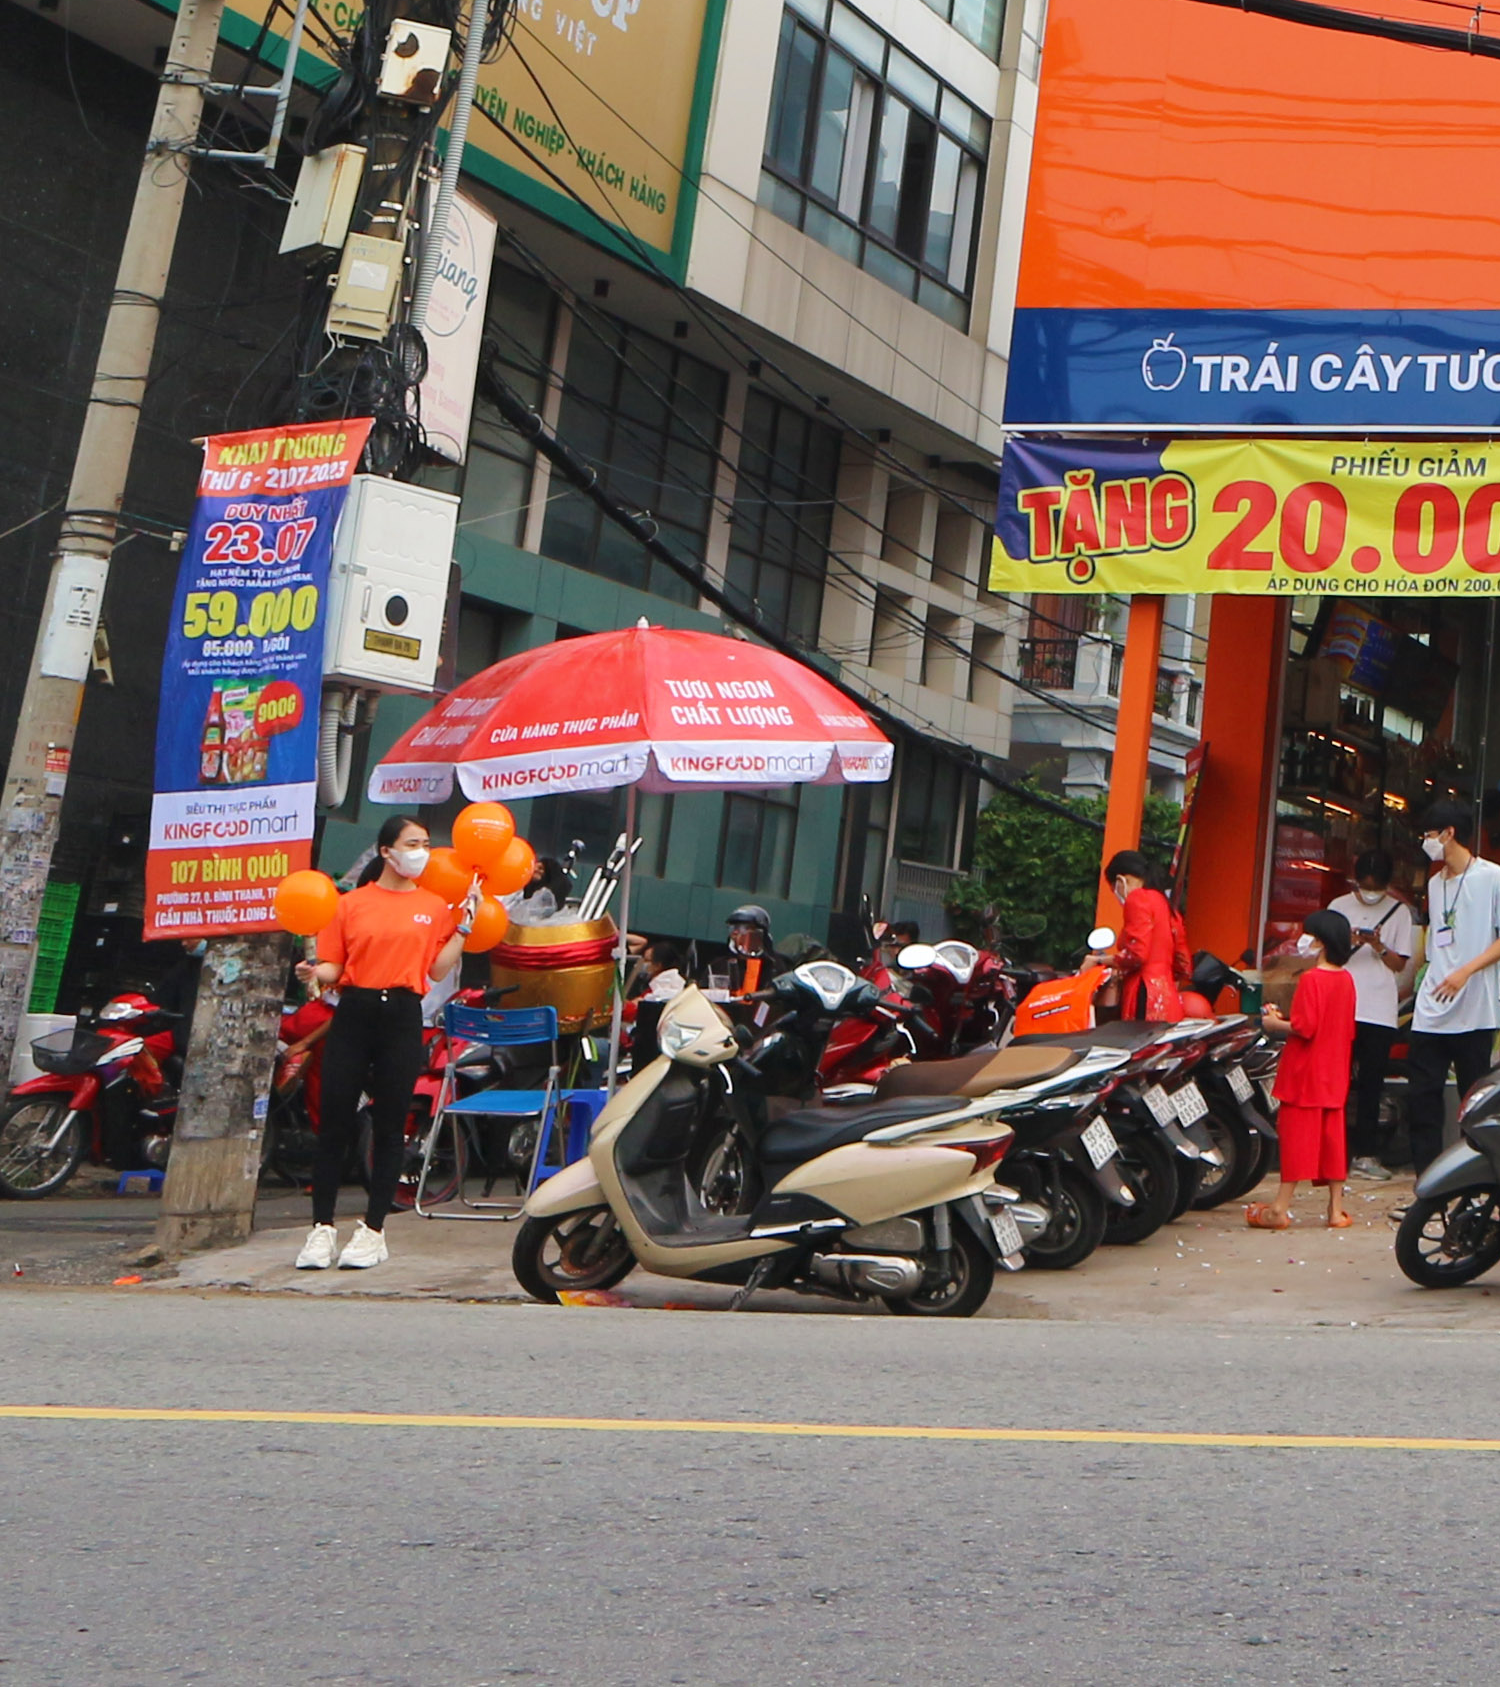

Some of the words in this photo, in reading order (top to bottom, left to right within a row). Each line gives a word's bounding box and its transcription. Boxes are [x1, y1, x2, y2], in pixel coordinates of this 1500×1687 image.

[555, 15, 599, 57] VIỆT
[512, 105, 565, 155] NGHIỆP
[576, 145, 625, 188] KHÁCH
[628, 173, 667, 215] HÀNG
[1193, 342, 1299, 393] TRÁI
[1310, 344, 1416, 392] CÂY
[218, 439, 269, 466] KHAI
[273, 433, 347, 462] TRƯƠNG
[201, 467, 241, 491] THỨ
[239, 470, 252, 490] 6
[224, 502, 267, 520] DUY
[268, 495, 308, 522] NHẤT
[1017, 467, 1196, 583] TẶNG
[1330, 450, 1410, 478] PHIẾU
[1417, 451, 1488, 478] GIẢM
[202, 516, 317, 565] 23.07
[1266, 573, 1289, 592] ÁP
[1292, 578, 1339, 597] DỤNG
[1343, 578, 1380, 594] CHO
[1383, 574, 1420, 594] HÓA
[1422, 576, 1460, 594] ĐƠN
[183, 585, 319, 639] 59.000
[664, 678, 713, 700] TƯƠI
[715, 678, 775, 700] NGON
[257, 694, 297, 723] 900G
[670, 700, 722, 726] CHẤT
[729, 704, 794, 730] LƯỢNG
[489, 723, 518, 744] CỬA
[521, 721, 560, 740] HÀNG
[561, 716, 598, 737] THỰC
[599, 708, 640, 730] PHẨM
[481, 753, 630, 791] KINGFOODmart
[670, 751, 816, 773] KINGFOODmart
[170, 859, 198, 885] 107
[201, 852, 243, 883] BÌNH
[239, 905, 268, 922] LONG
